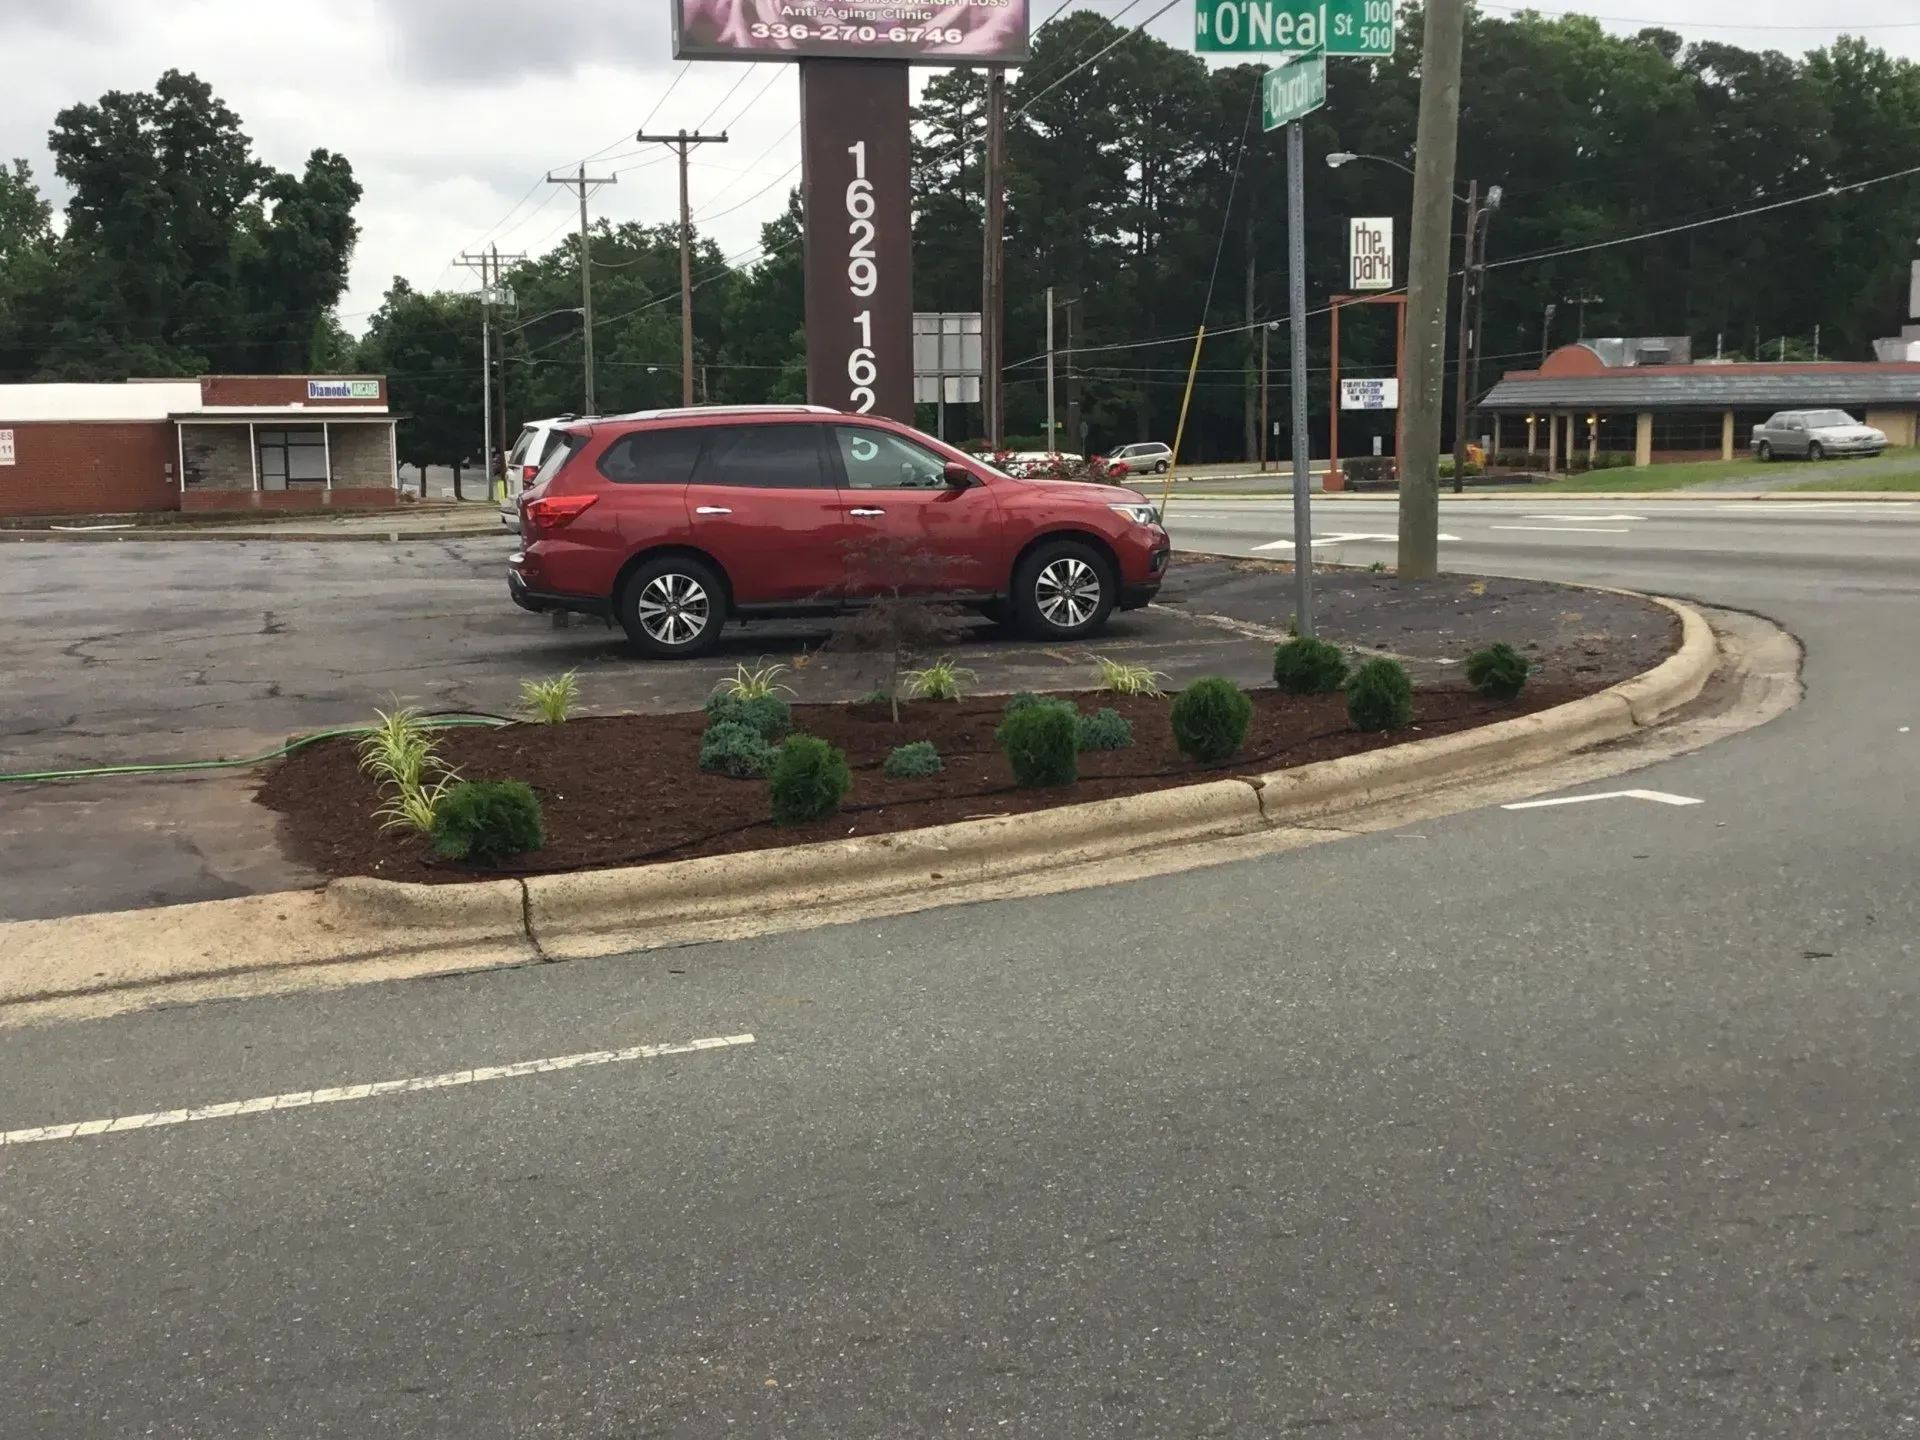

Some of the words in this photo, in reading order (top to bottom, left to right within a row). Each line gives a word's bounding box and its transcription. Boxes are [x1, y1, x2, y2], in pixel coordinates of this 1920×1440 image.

[781, 5, 877, 20] Anti-Aging
[882, 8, 932, 20] Clinic
[1197, 12, 1208, 35] N
[1215, 1, 1327, 46] O'Neal
[1333, 13, 1354, 36] St
[1364, 0, 1391, 24] 100
[750, 22, 963, 44] 336-270-6746
[1360, 26, 1391, 49] 500
[1270, 71, 1308, 119] Church
[845, 140, 878, 297] 1629
[1355, 221, 1382, 255] the
[1353, 246, 1391, 290] park
[309, 382, 351, 397] Diamonds
[353, 383, 377, 396] ARCADE
